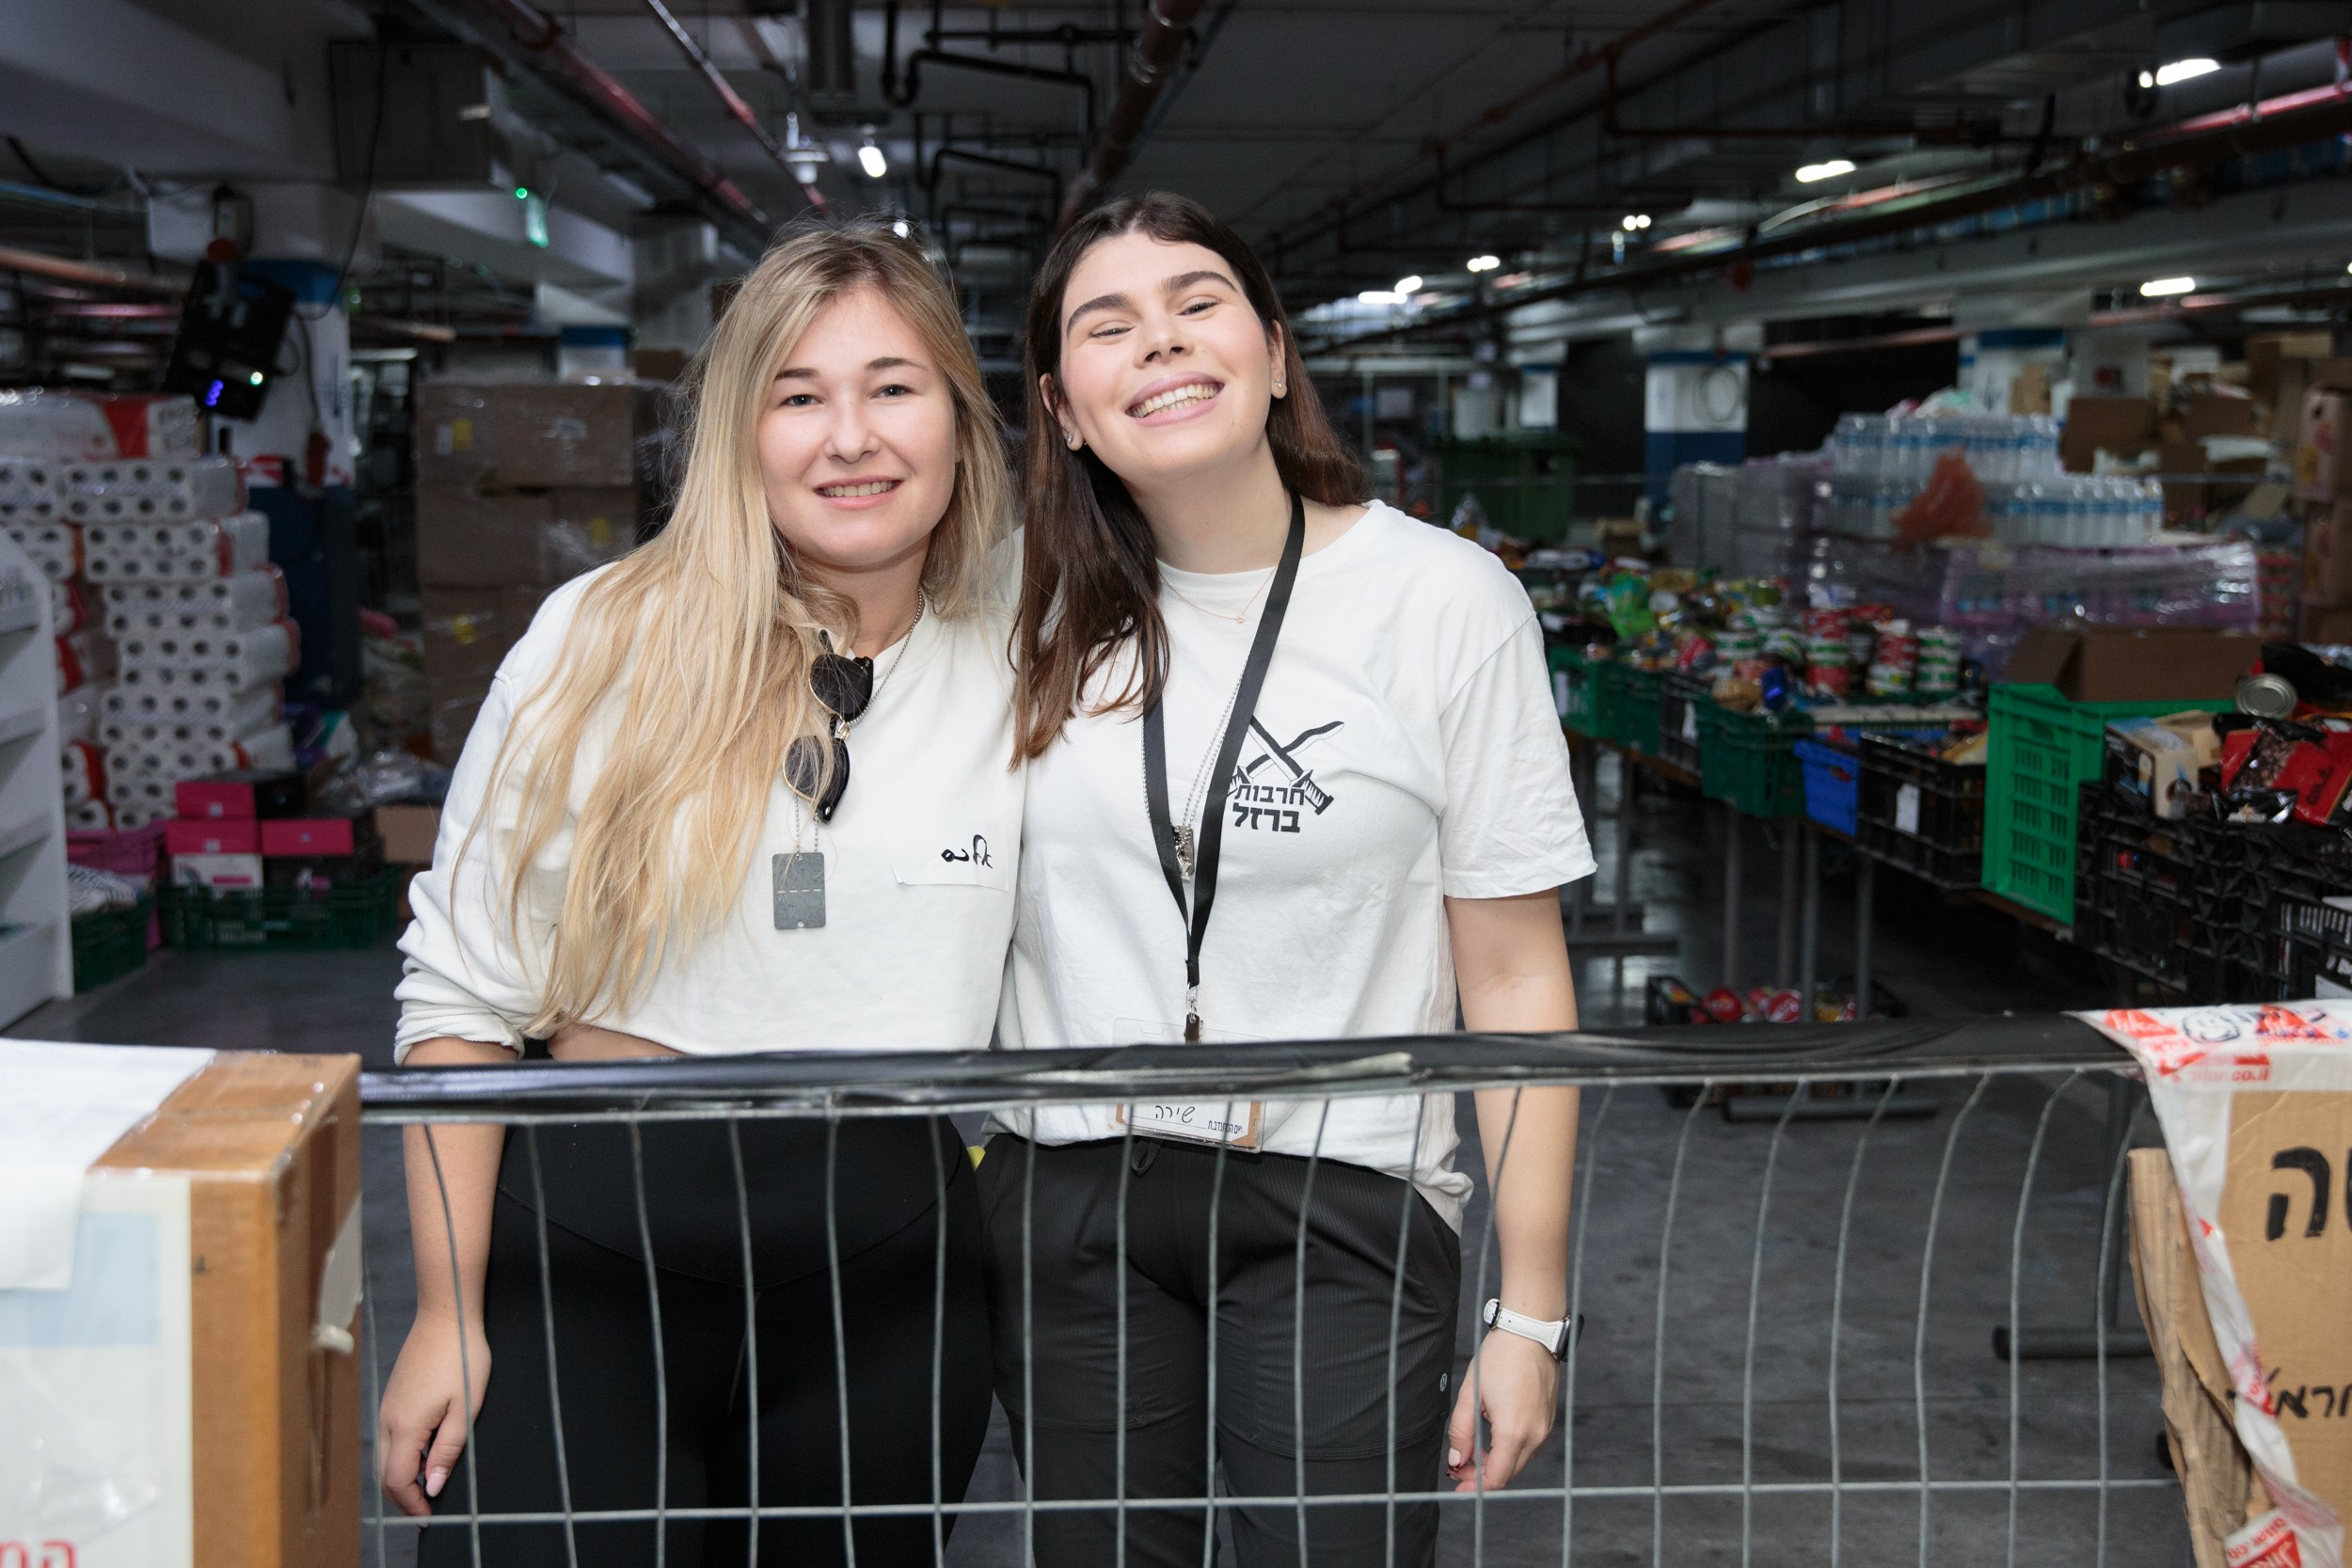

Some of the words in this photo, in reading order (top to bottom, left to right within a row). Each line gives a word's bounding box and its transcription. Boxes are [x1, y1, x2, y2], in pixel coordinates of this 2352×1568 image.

[1234, 784, 1305, 806] חרבות
[1232, 802, 1301, 833] ברזל
[1155, 1104, 1196, 1124] שירה
